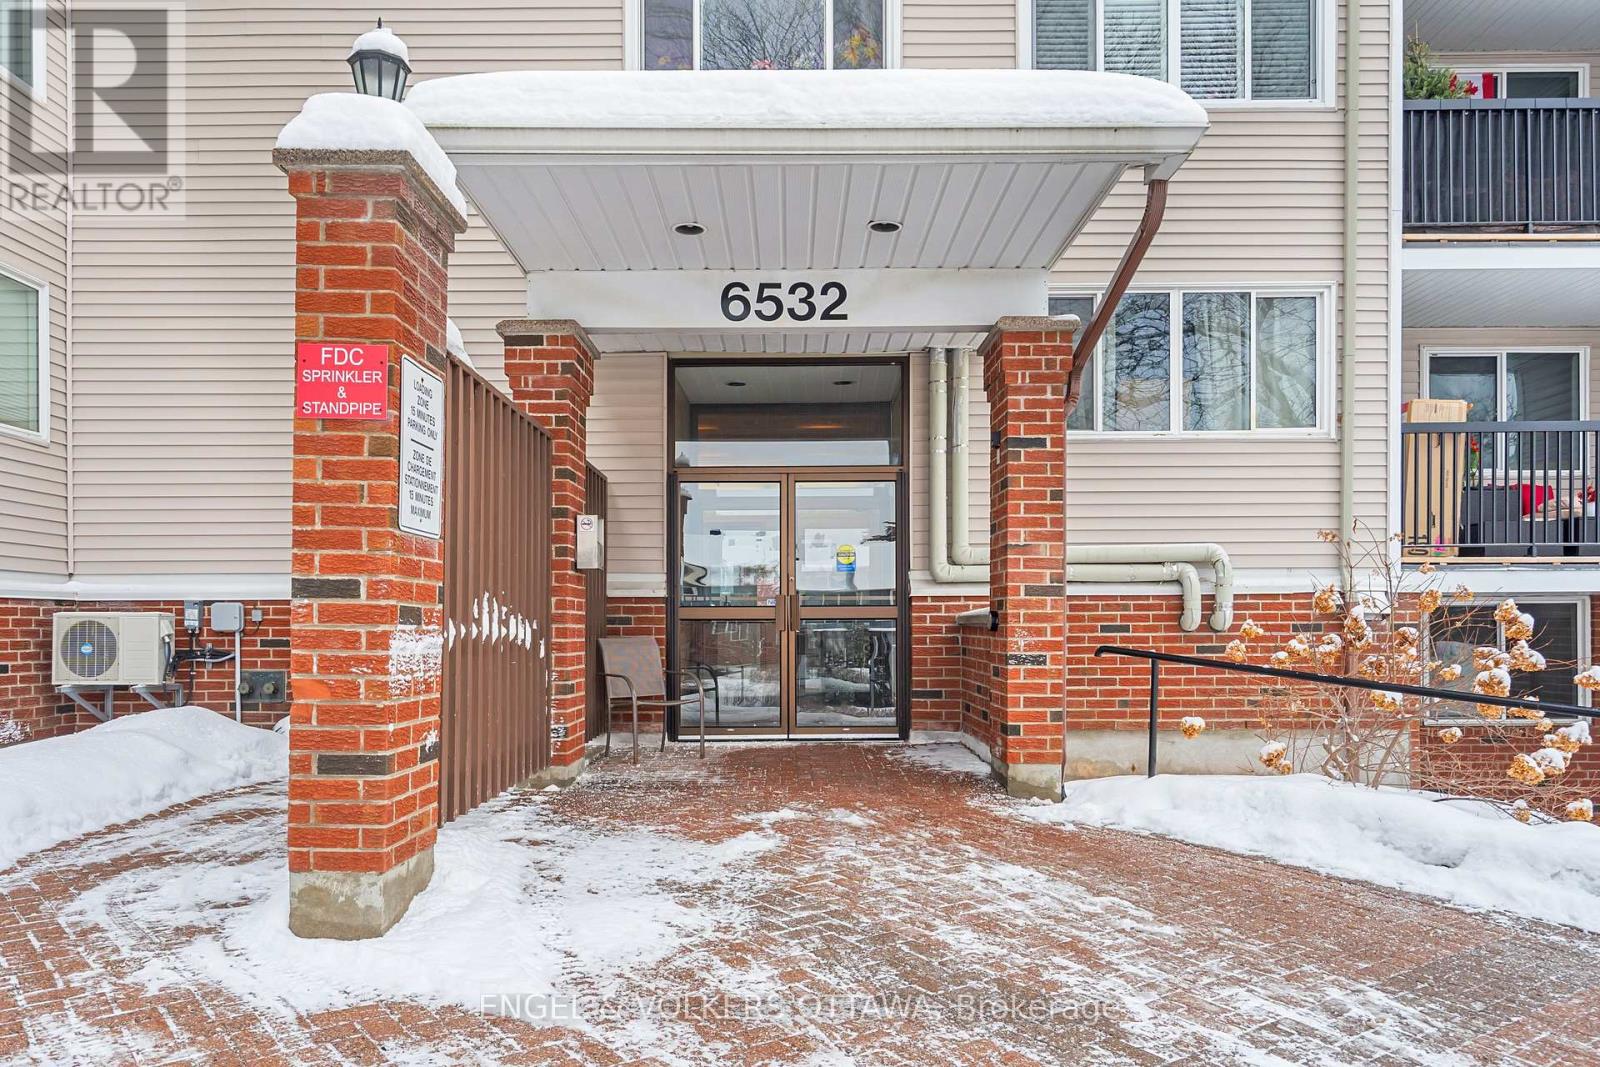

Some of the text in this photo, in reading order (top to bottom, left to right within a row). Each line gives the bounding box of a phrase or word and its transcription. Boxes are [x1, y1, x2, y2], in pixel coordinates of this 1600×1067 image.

[720, 281, 848, 322] 6532
[321, 347, 364, 366] FDC
[302, 370, 383, 383] SPRINKLER
[337, 386, 347, 399] &
[413, 379, 433, 399] LOADING
[302, 401, 382, 415] STANDPIPE
[416, 395, 429, 410] ZONE
[410, 405, 436, 427] 15 MINUTES
[407, 417, 438, 441] PARKING ONLY
[412, 449, 432, 467] ZONE DE
[407, 461, 437, 482] CHARGEMENT
[404, 474, 439, 495] STATIONNEMENT
[409, 490, 434, 507] 15 MINUTES
[410, 505, 431, 520] MAXIMUM
